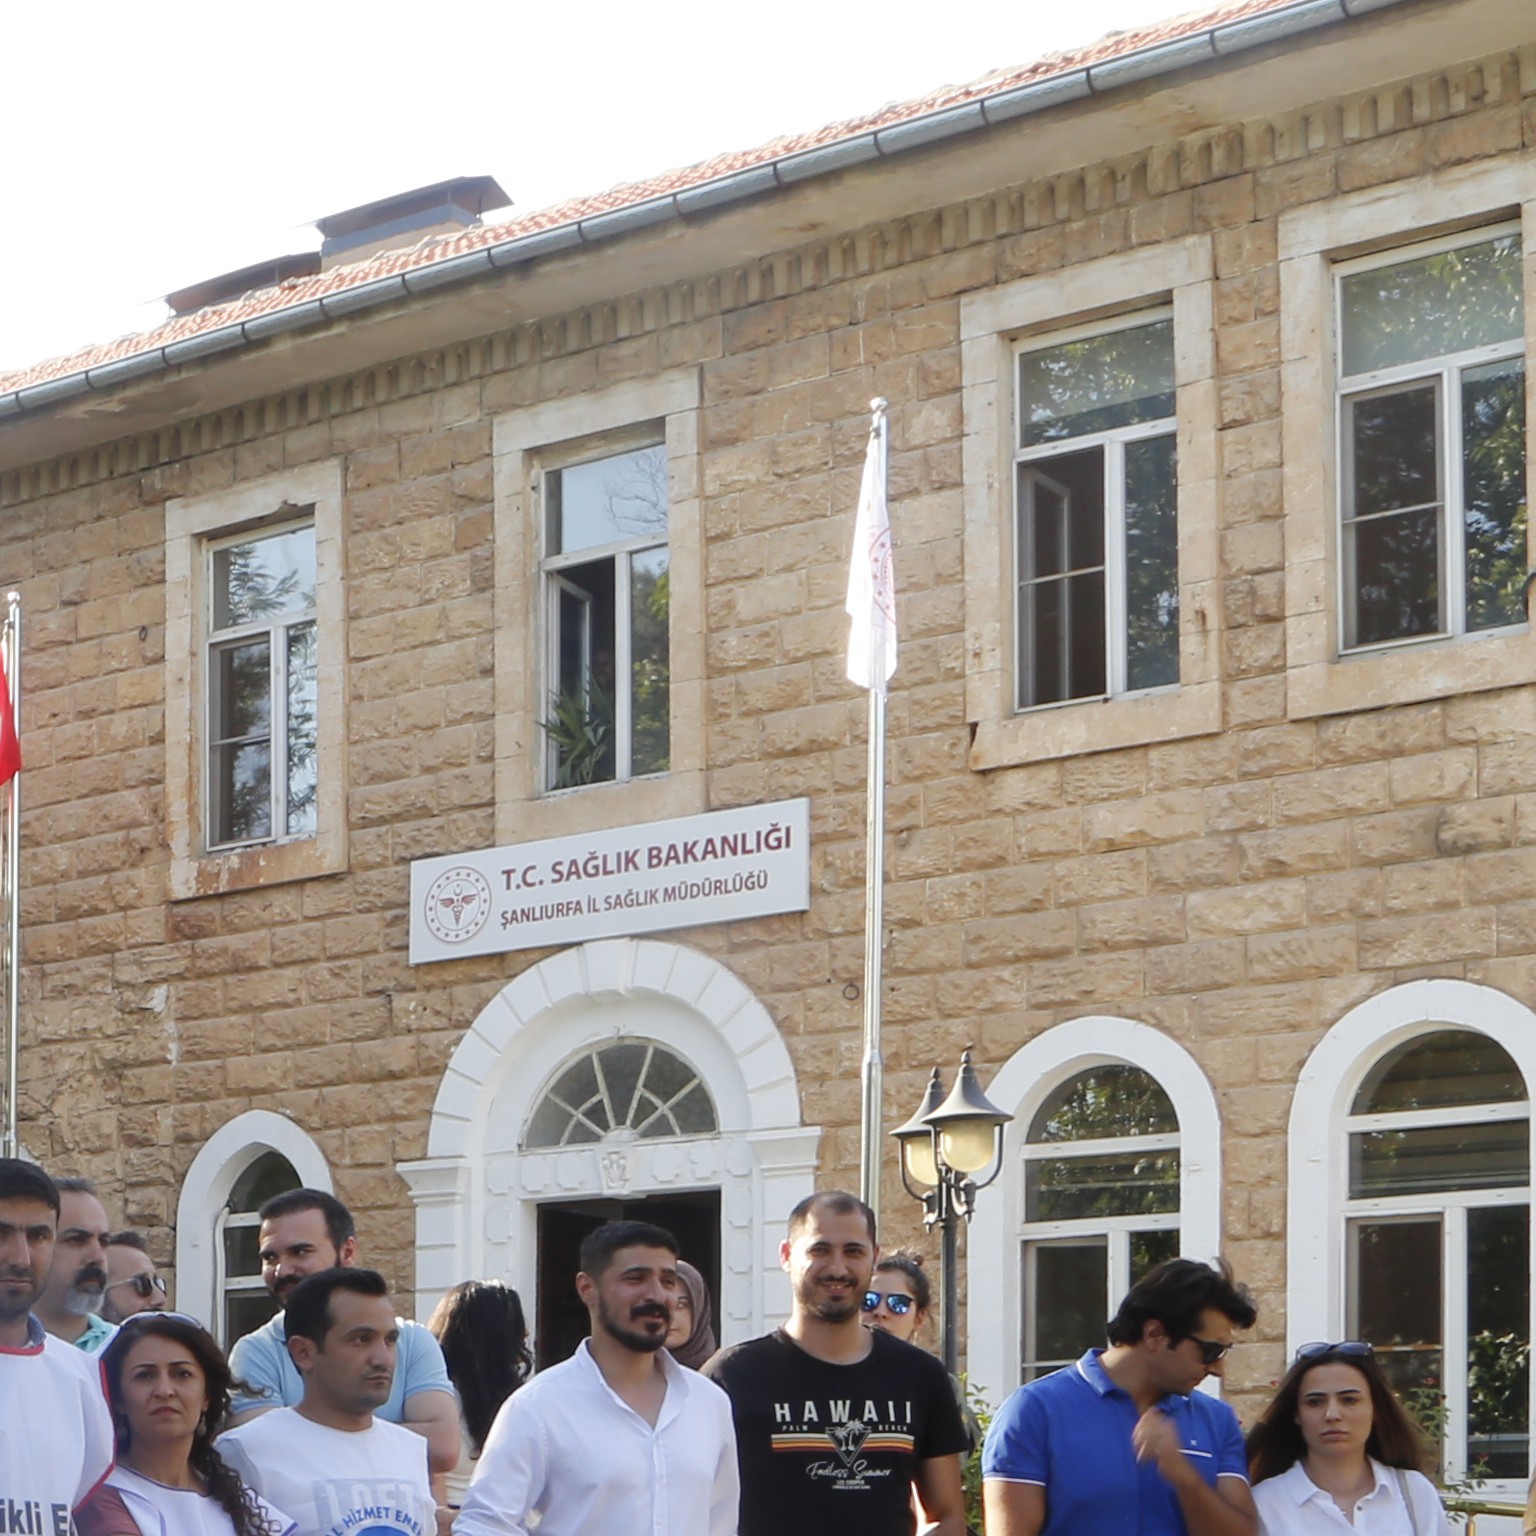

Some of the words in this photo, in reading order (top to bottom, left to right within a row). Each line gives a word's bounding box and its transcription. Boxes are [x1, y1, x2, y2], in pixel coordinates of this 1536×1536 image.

[501, 863, 545, 891] T.C.
[550, 849, 640, 886] SAĞLIK
[647, 822, 792, 869] BAKANLIĞI
[499, 899, 584, 930] ŞANLIURFA
[587, 893, 601, 914] İL
[603, 885, 660, 912] SAĞLIK
[663, 868, 768, 903] MÜDÜRLÜĞÜ
[774, 1400, 911, 1424] HAWAII
[782, 1424, 809, 1432] PALM
[879, 1423, 908, 1432] BEACH
[806, 1461, 849, 1480] Endless
[853, 1459, 892, 1480] Summer
[342, 1506, 391, 1529] HİZMET
